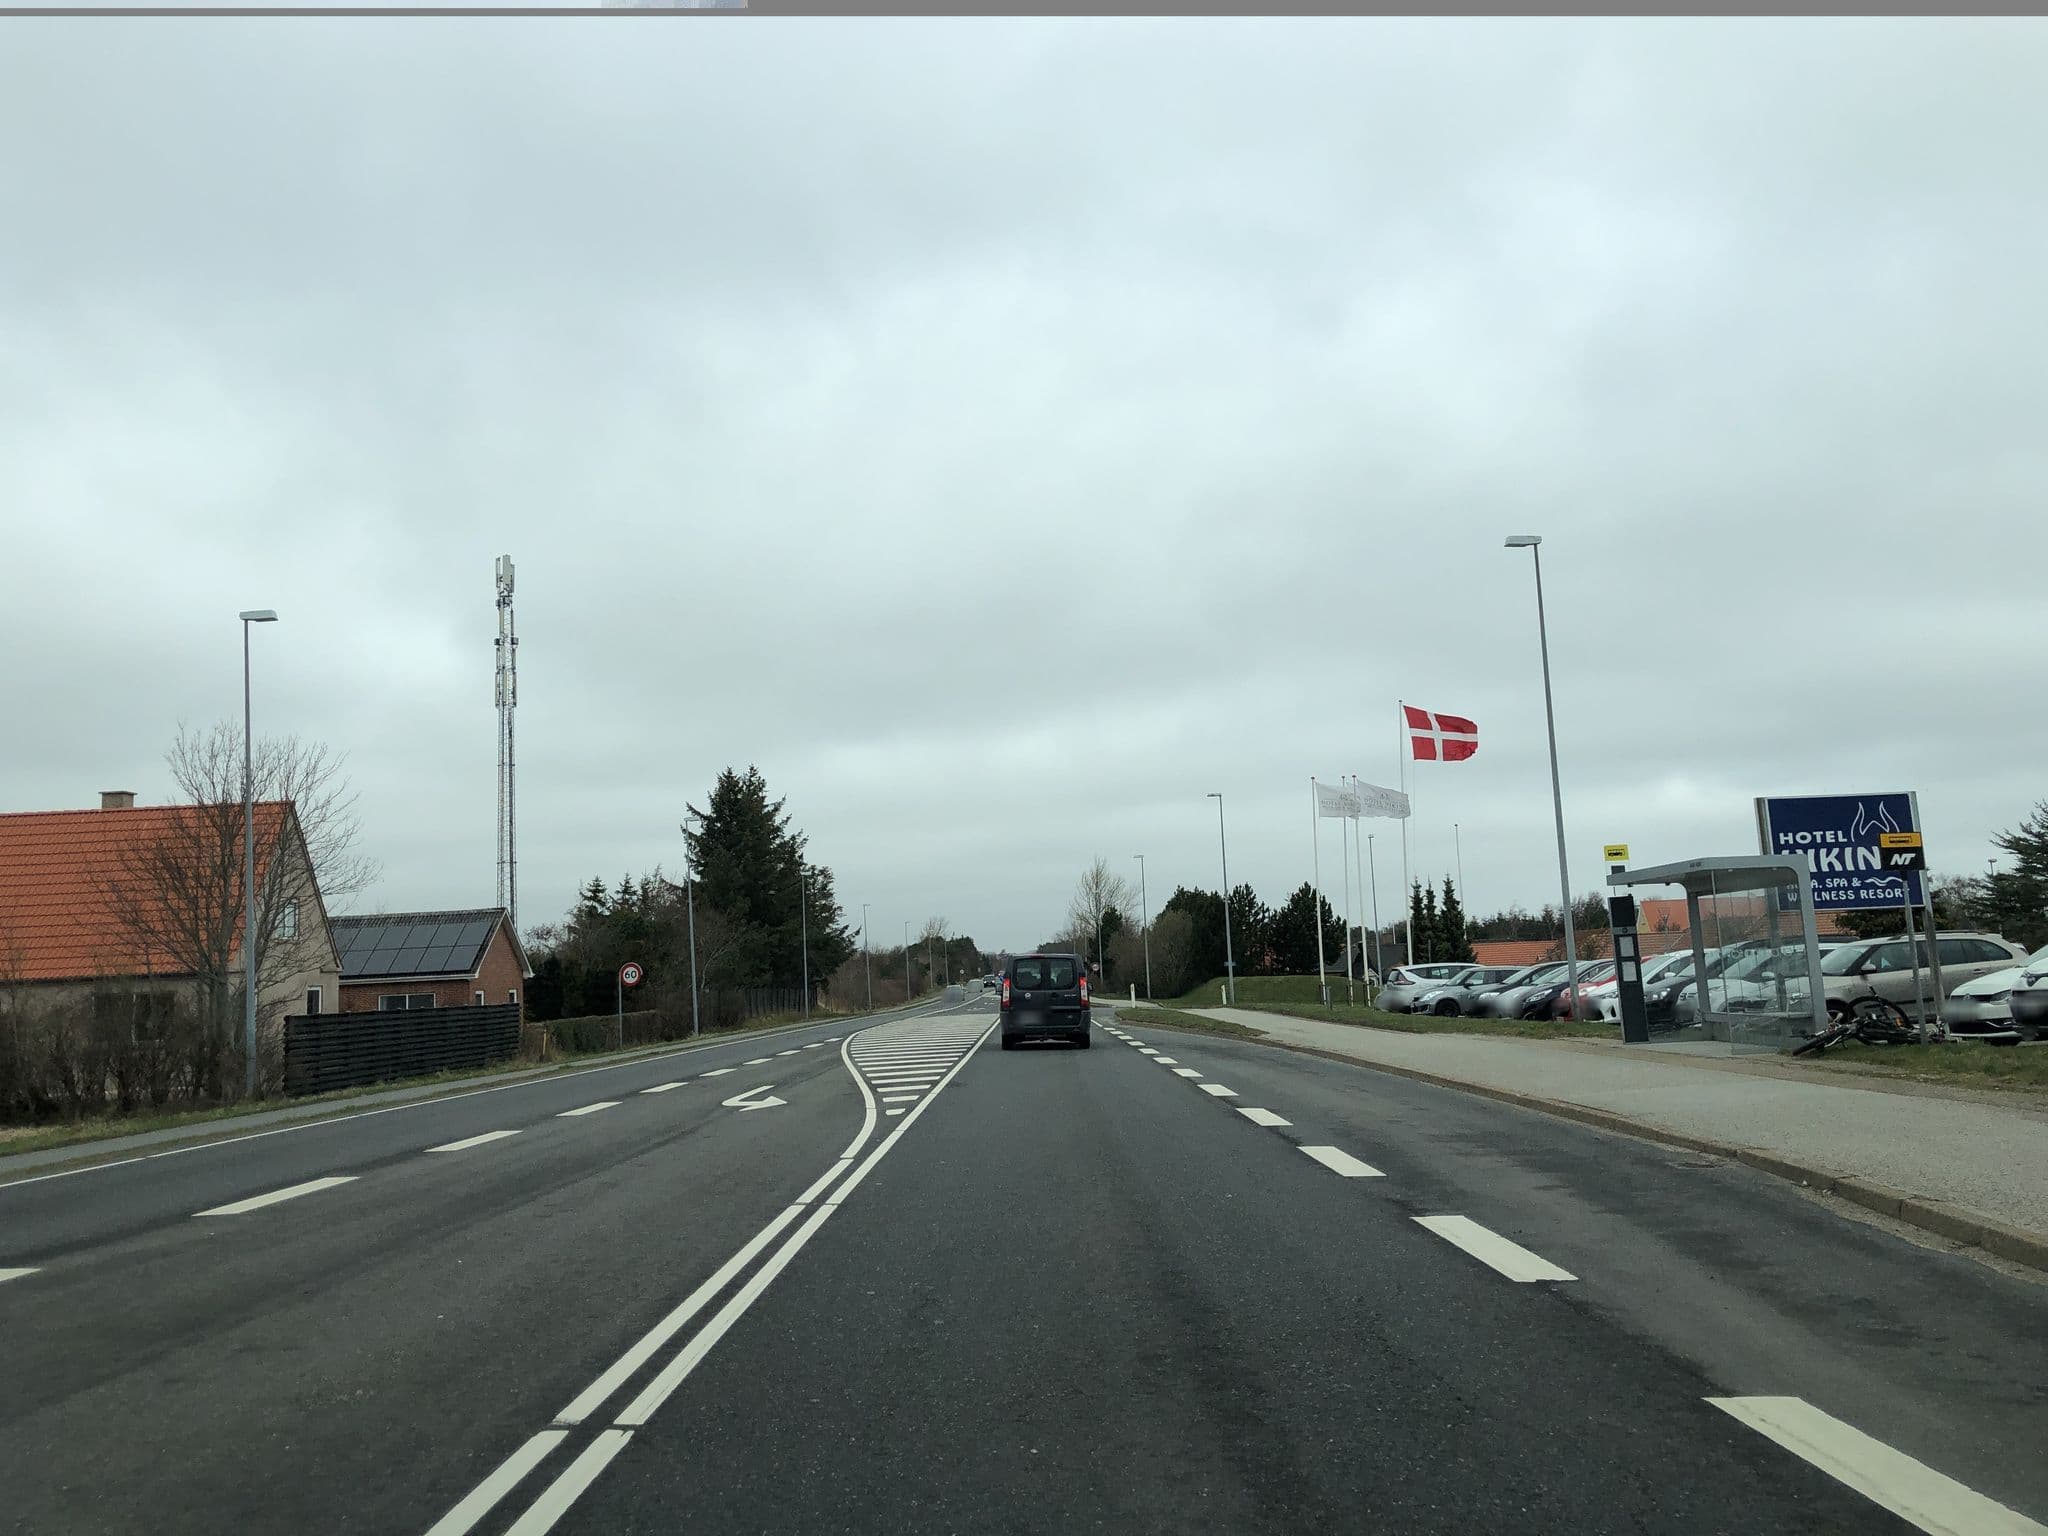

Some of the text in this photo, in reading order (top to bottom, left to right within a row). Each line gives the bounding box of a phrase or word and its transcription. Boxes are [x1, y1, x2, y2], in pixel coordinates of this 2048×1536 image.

[1779, 830, 1848, 844] HOTEL
[1781, 846, 1882, 873] IKIN
[1890, 853, 1916, 866] NT
[1825, 878, 1848, 888] SPA
[1851, 877, 1862, 887] &
[1787, 890, 1855, 902] WLNESS
[624, 970, 636, 978] 60
